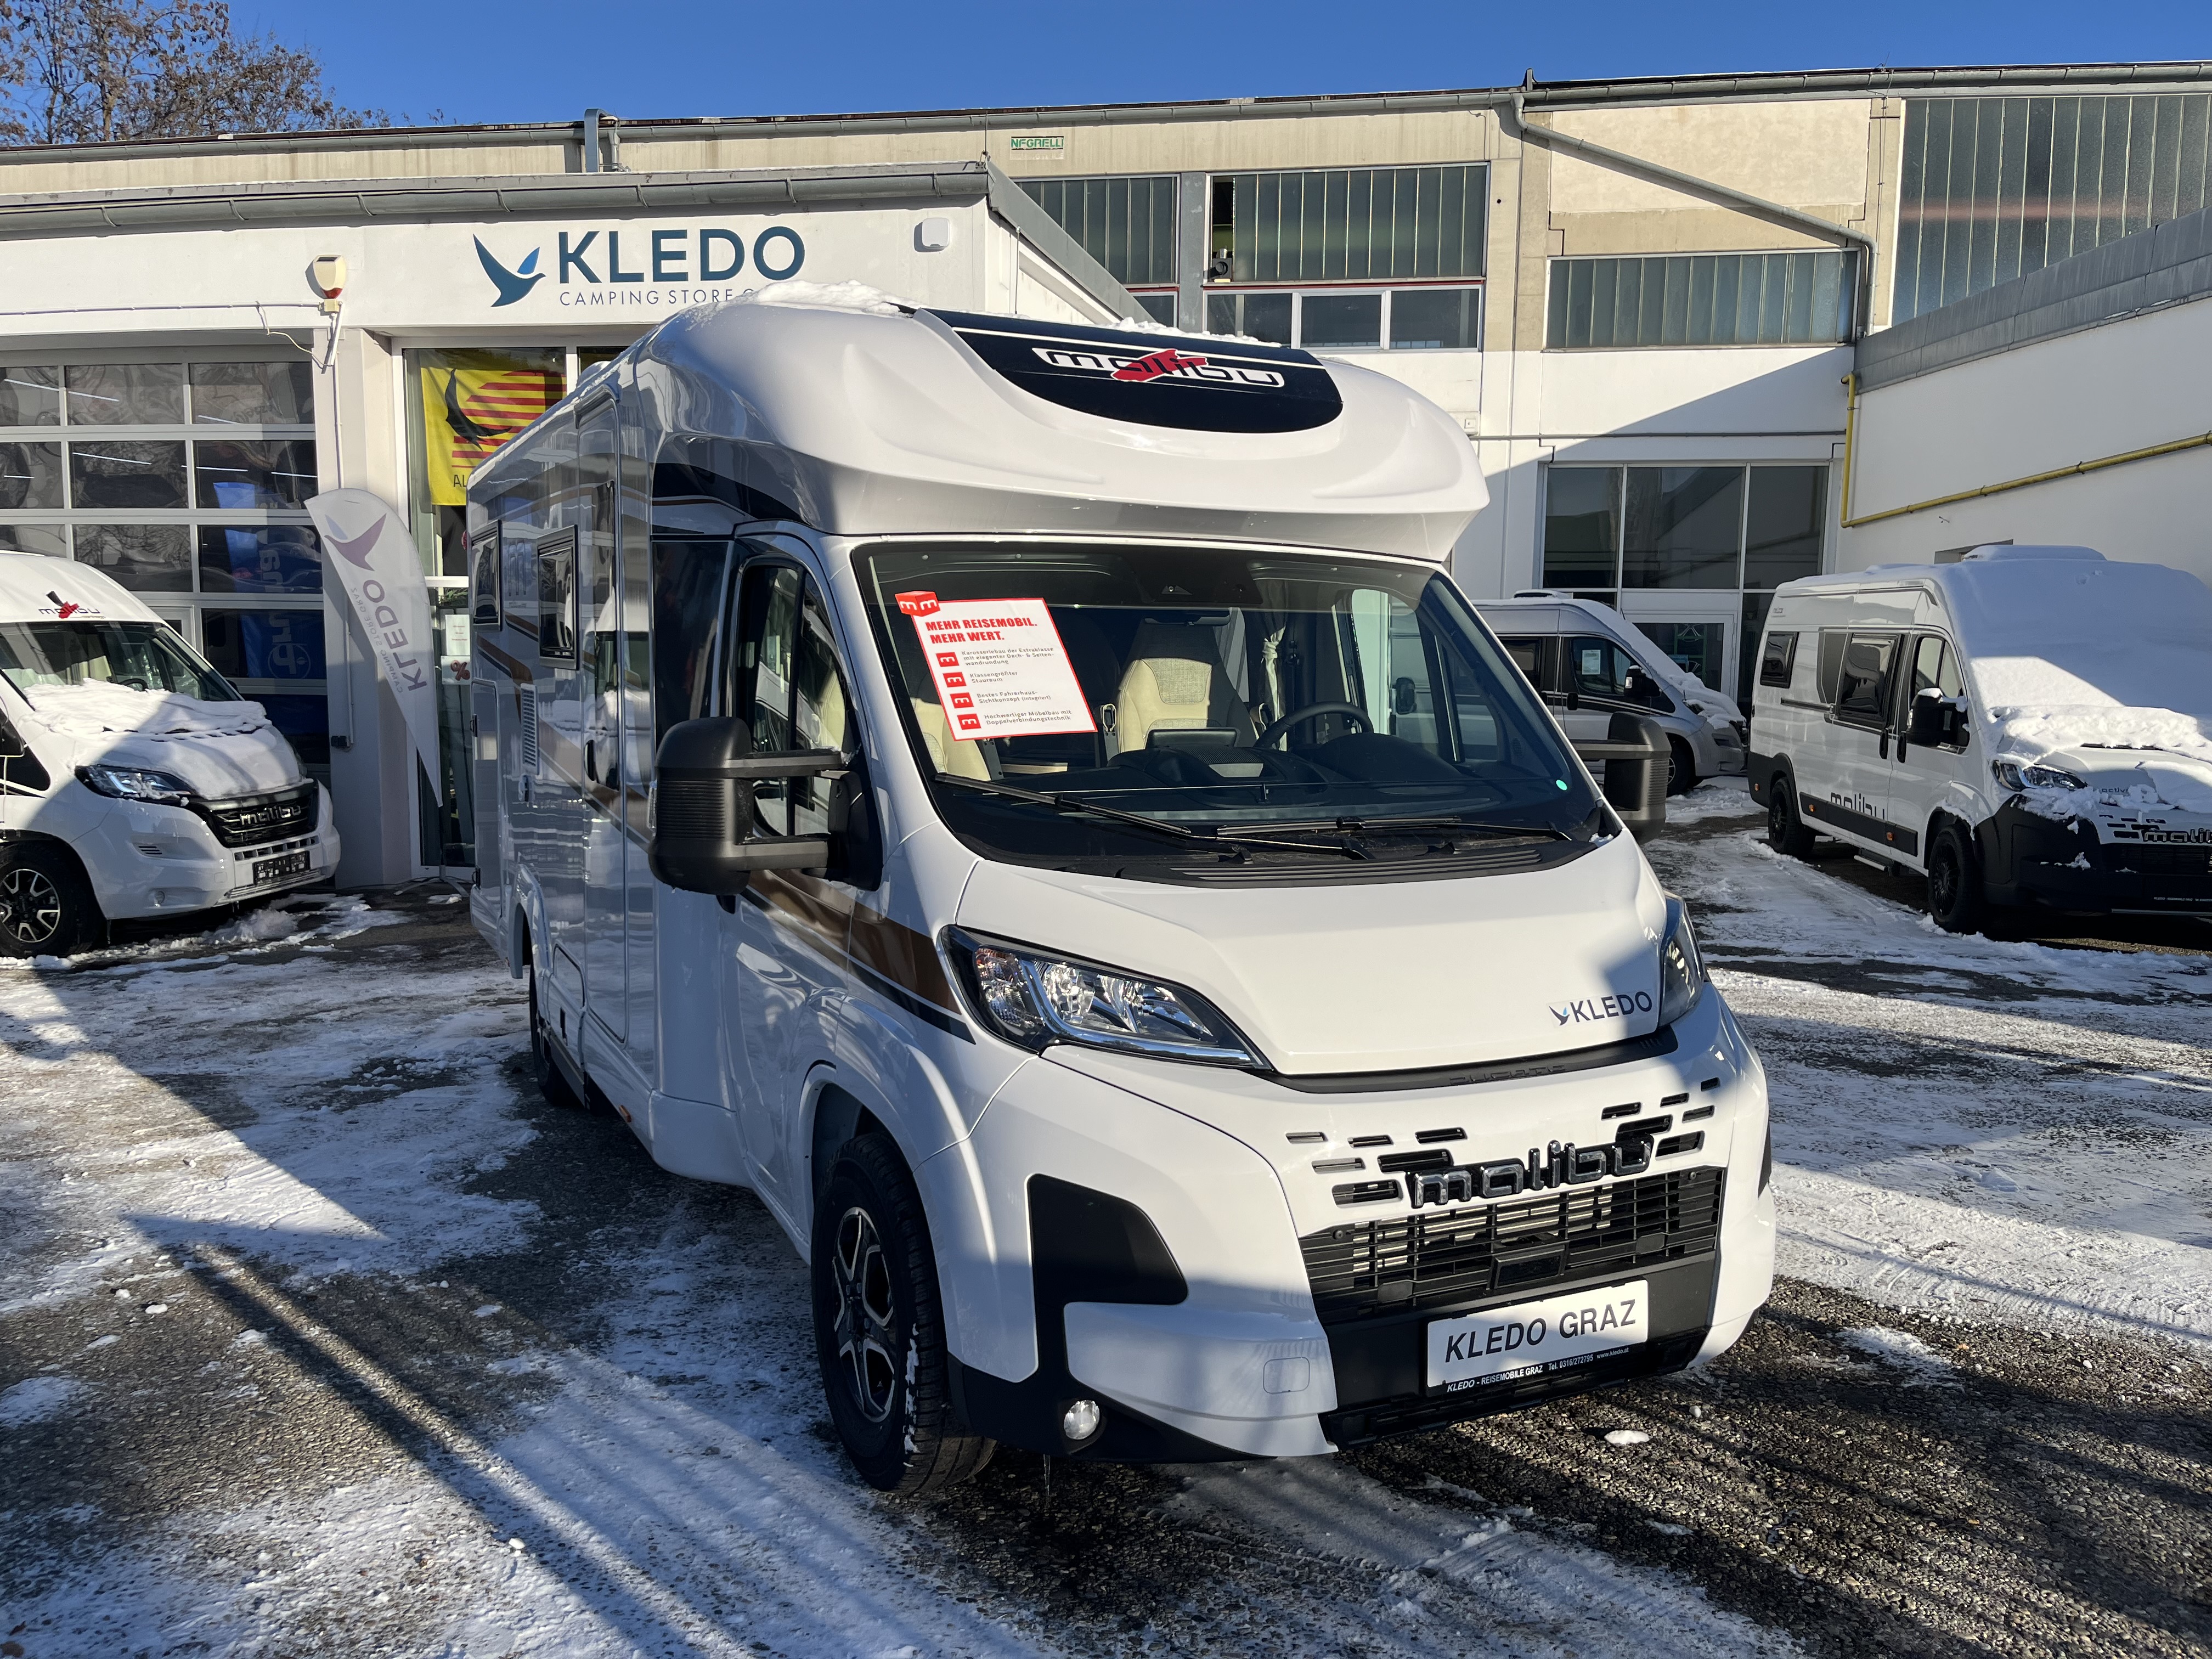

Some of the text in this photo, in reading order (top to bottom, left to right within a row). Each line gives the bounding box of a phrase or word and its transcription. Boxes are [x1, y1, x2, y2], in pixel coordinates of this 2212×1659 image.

[559, 226, 805, 284] KLEDO
[560, 290, 659, 306] CAMPING
[668, 289, 733, 304] STORE
[1045, 349, 1282, 386] malibu
[926, 617, 1037, 631] MEHR REISEMOBIL.
[930, 631, 1005, 644] MEHR WERT.
[986, 715, 1071, 725] Doppelverbindungstechnik
[240, 805, 301, 825] malibu
[1571, 991, 1652, 1023] KLEDO
[1410, 1140, 1654, 1209] malibu
[1444, 1299, 1636, 1363] KLEDO GRAZ
[1447, 1379, 1476, 1392] KLEDO
[1481, 1368, 1525, 1385] REISEMOBILE
[1525, 1365, 1543, 1376] GRAZ
[1548, 1362, 1558, 1371] Tel.
[1559, 1353, 1594, 1370] 0316/272795
[1596, 1347, 1629, 1359] www.kledo.at
